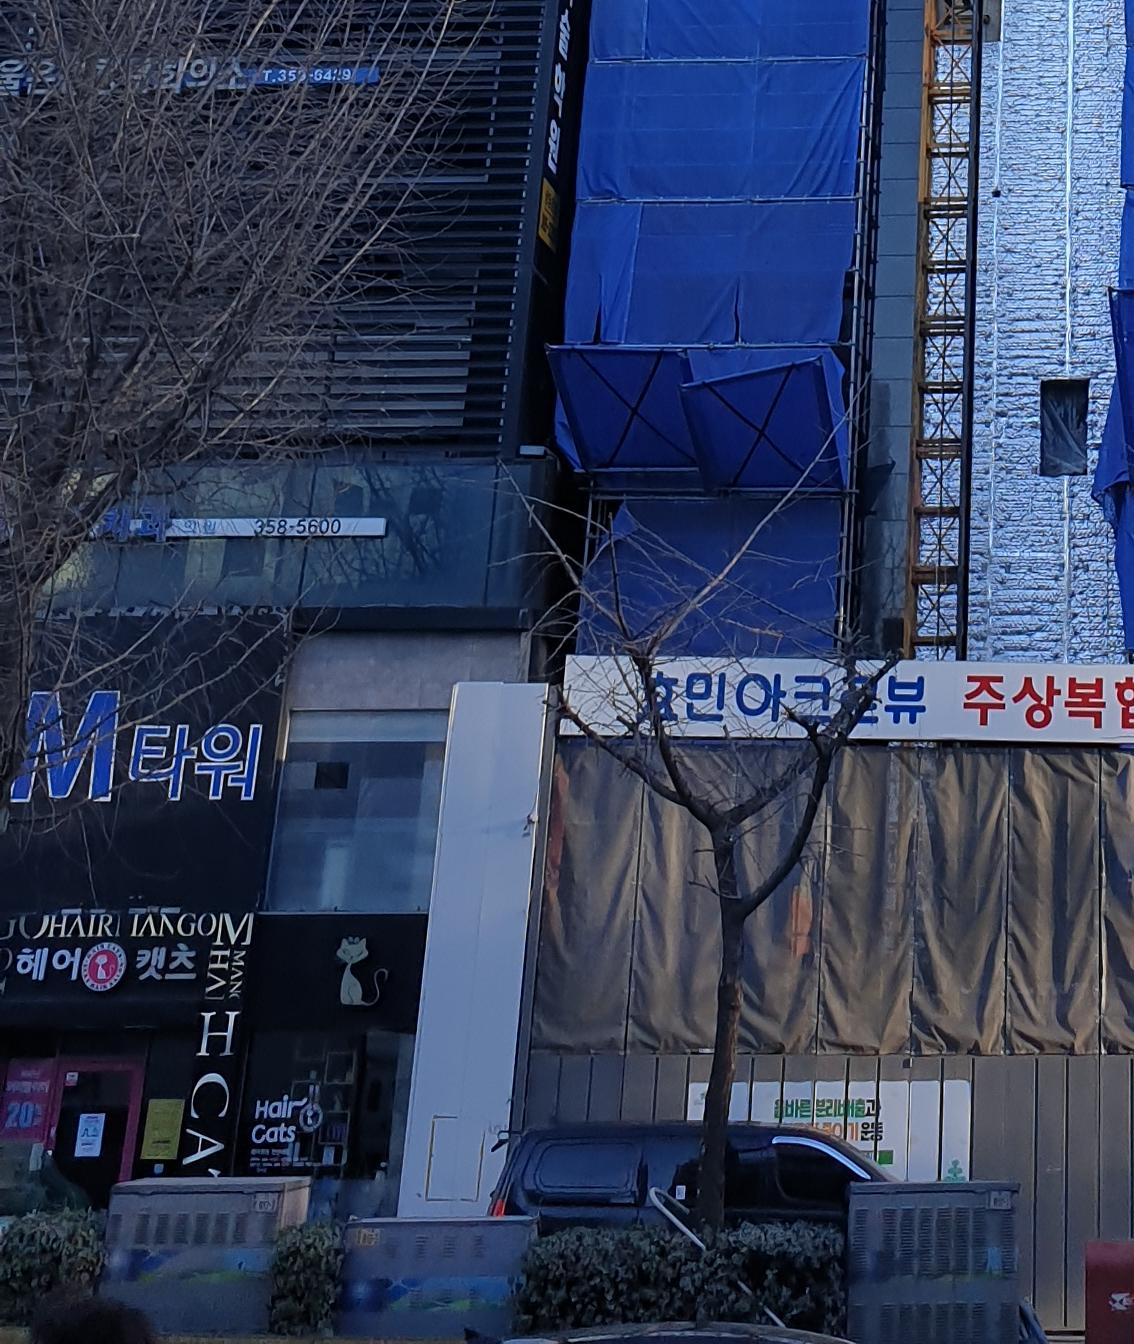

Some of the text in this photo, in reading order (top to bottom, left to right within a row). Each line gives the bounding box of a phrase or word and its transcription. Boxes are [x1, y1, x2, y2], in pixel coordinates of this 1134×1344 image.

[16, 946, 82, 982] 헤어
[254, 1094, 308, 1120] Hair
[251, 1122, 297, 1144] Cats
